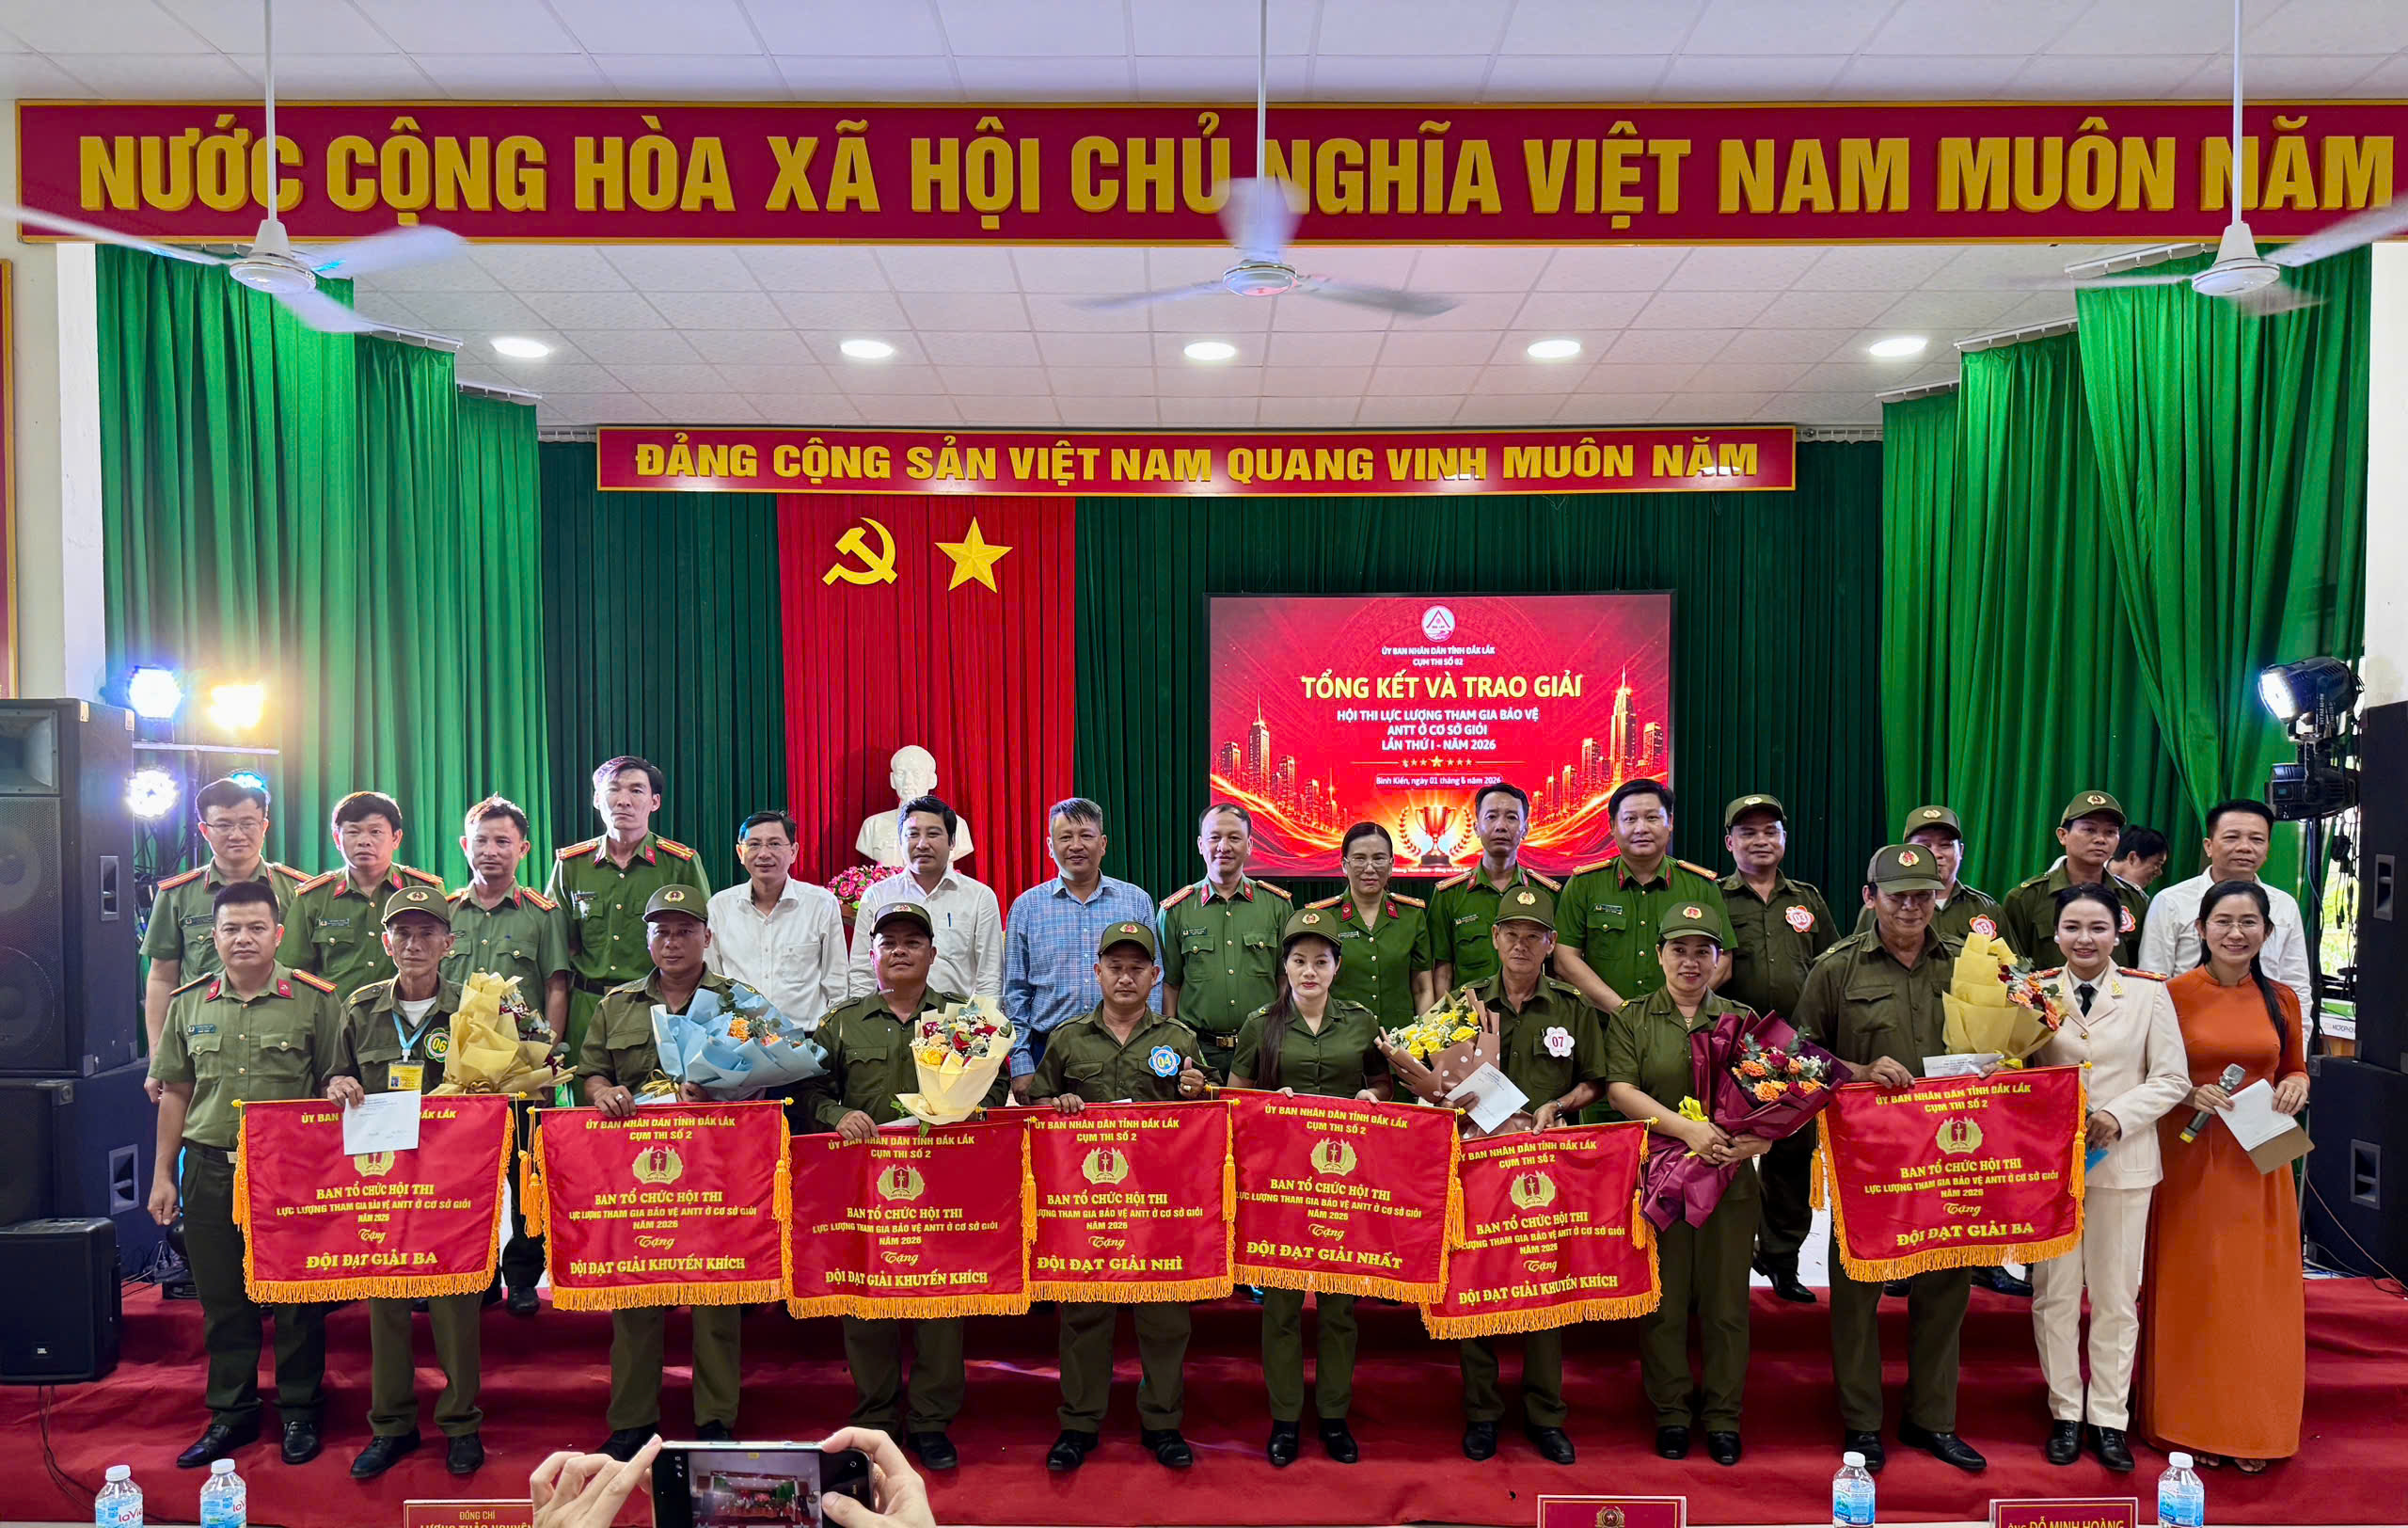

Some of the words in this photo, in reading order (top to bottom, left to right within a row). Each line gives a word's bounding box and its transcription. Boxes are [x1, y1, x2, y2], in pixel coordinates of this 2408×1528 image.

[79, 114, 305, 212] NƯỚC
[326, 116, 547, 226] CỘNG
[574, 115, 736, 212] HÒA
[765, 119, 880, 213] XÃ
[911, 116, 1039, 230] HỘI
[1070, 112, 1231, 214] CHỦ
[1264, 119, 1502, 214] NGHĨA
[1523, 120, 1690, 229] VIỆT
[1719, 137, 1909, 214] NAM
[1937, 115, 2176, 213] MUÔN
[2199, 115, 2394, 212] NĂM
[636, 433, 756, 480] ĐẢNG
[774, 438, 890, 484] CỘNG
[907, 436, 995, 483] SẢN
[1009, 440, 1100, 485] VIỆT
[1112, 449, 1212, 484] NAM
[1226, 449, 1372, 485] QUANG
[1386, 448, 1488, 484] VINH
[1503, 438, 1633, 478] MUÔN
[1653, 437, 1757, 479] NĂM
[1301, 668, 1370, 699] TỔNG
[1376, 669, 1419, 698] KẾT
[1424, 671, 1458, 698] VÀ
[1463, 676, 1528, 698] TRAO
[1533, 669, 1584, 698] GIẢI
[1337, 708, 1358, 723] HỘI
[1360, 708, 1378, 721] THI
[1380, 708, 1402, 723] LỰC
[1445, 708, 1477, 720] THAM
[1479, 708, 1497, 720] GIA
[1500, 707, 1523, 720] BẢO
[1525, 707, 1539, 722] VỆ
[1387, 724, 1417, 736] ANTT
[1429, 724, 1445, 736] CƠ
[1447, 723, 1462, 736] SỞ
[1405, 739, 1429, 751] THỨ
[1431, 740, 1434, 750] I
[1443, 739, 1468, 751] NĂM
[1470, 740, 1497, 751] 2026
[1484, 776, 1501, 785] 2026
[2332, 1024, 2355, 1033] MICROPHO
[432, 1037, 448, 1053] 06
[1552, 1036, 1564, 1048] 07
[1157, 1055, 1172, 1068] 04
[1077, 1134, 1098, 1143] CỤM
[1100, 1133, 1114, 1141] THI
[1117, 1130, 1129, 1140] SỐ
[1307, 1122, 1327, 1131] CỤM
[1330, 1123, 1343, 1132] THI
[1346, 1123, 1357, 1134] SỐ
[1900, 1167, 1925, 1178] BAN
[1928, 1159, 1942, 1174] TỔ
[1945, 1159, 1977, 1172] CHỨC
[1980, 1157, 2001, 1172] HỘI
[2003, 1158, 2021, 1170] THI
[317, 1187, 342, 1200] BAN
[345, 1181, 360, 1197] TỔ
[362, 1182, 387, 1196] CHỨC
[388, 1183, 409, 1197] HỘI
[412, 1185, 435, 1195] THI
[594, 1194, 617, 1205] BAN
[620, 1187, 637, 1204] TỔ
[640, 1189, 673, 1203] CHỨC
[677, 1190, 699, 1204] HỘI
[702, 1192, 722, 1202] THI
[1271, 1179, 1294, 1190] BAN
[1297, 1176, 1312, 1191] TỔ
[1315, 1182, 1346, 1195] CHỨC
[1349, 1185, 1369, 1199] HỘI
[1371, 1189, 1390, 1201] THI
[1047, 1195, 1070, 1204] BAN
[1073, 1189, 1088, 1204] TỔ
[1091, 1191, 1122, 1204] CHỨC
[1126, 1191, 1145, 1206] HỘI
[1148, 1194, 1167, 1204] THI
[848, 1208, 865, 1218] BAN
[867, 1204, 881, 1219] TỔ
[884, 1206, 916, 1219] CHỨC
[920, 1206, 940, 1220] HỘI
[943, 1209, 962, 1218] THI
[1307, 1209, 1327, 1218] NĂM
[1329, 1212, 1348, 1220] 2026
[1476, 1222, 1500, 1234] BAN
[1502, 1215, 1518, 1231] TỔ
[1521, 1214, 1551, 1228] CHỨC
[1553, 1212, 1568, 1226] HỘI
[1570, 1212, 1588, 1222] THI
[1308, 1224, 1344, 1241] Tặng
[1896, 1230, 1925, 1246] ĐỘI
[1928, 1226, 1962, 1240] ĐẠT
[1968, 1220, 2006, 1236] GIẢI
[2012, 1223, 2034, 1234] BA
[306, 1252, 339, 1270] ĐỘI
[342, 1254, 369, 1268] ĐẠT
[372, 1249, 407, 1265] GIẢI
[413, 1252, 437, 1265] BA
[1246, 1240, 1275, 1256] ĐỘI
[1279, 1245, 1314, 1260] ĐẠT
[1318, 1246, 1353, 1262] GIẢI
[1356, 1251, 1402, 1268] NHẤT
[570, 1259, 587, 1277] ĐỘI
[589, 1262, 614, 1277] ĐẠT
[617, 1256, 645, 1272] GIẢI
[649, 1253, 704, 1271] KHUYẾN
[706, 1255, 745, 1269] KHÍCH
[1038, 1255, 1066, 1272] ĐỘI
[1069, 1259, 1104, 1273] ĐẠT
[1109, 1254, 1146, 1271] GIẢI
[1151, 1256, 1182, 1270] NHÌ
[826, 1268, 846, 1284] ĐỘI
[848, 1271, 865, 1285] ĐẠT
[867, 1271, 892, 1286] GIẢI
[895, 1269, 946, 1287] KHUYẾN
[950, 1269, 988, 1284] KHÍCH
[1459, 1289, 1481, 1306] ĐỘI
[1483, 1287, 1508, 1302] ĐẠT
[1511, 1281, 1538, 1297] GIẢI
[1540, 1274, 1576, 1295] KHUYẾN
[1580, 1273, 1618, 1288] KHÍCH
[459, 1510, 481, 1520] ĐỒNG
[482, 1510, 496, 1520] CHÍ
